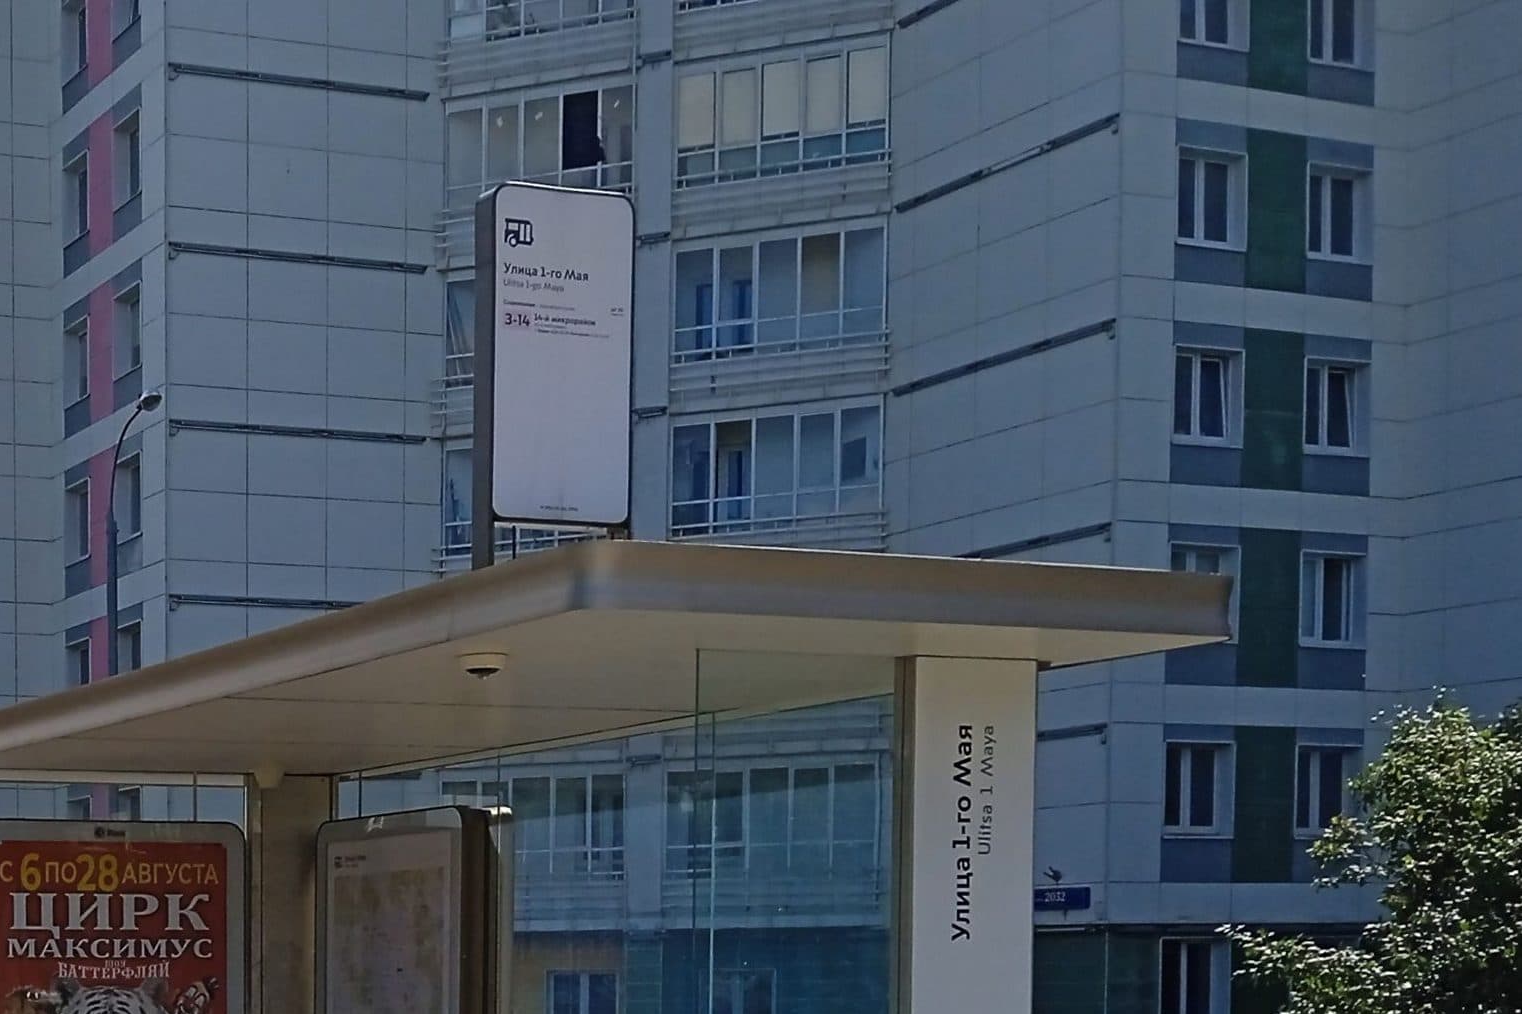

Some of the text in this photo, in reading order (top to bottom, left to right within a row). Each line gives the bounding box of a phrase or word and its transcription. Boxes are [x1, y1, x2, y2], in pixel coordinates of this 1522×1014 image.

[503, 262, 589, 281] Улица 1-го Мая
[504, 312, 530, 327] 3-14
[977, 725, 997, 855] Ulitsa 1 Maya
[951, 724, 973, 941] Улица 1-го Мая
[0, 853, 219, 892] С 6 ПО 28 АВГУСТА
[9, 892, 210, 939] ЦИРК
[7, 938, 213, 958] МАКСИМУС
[58, 960, 170, 979] БАТТЕРФЛЯЙ
